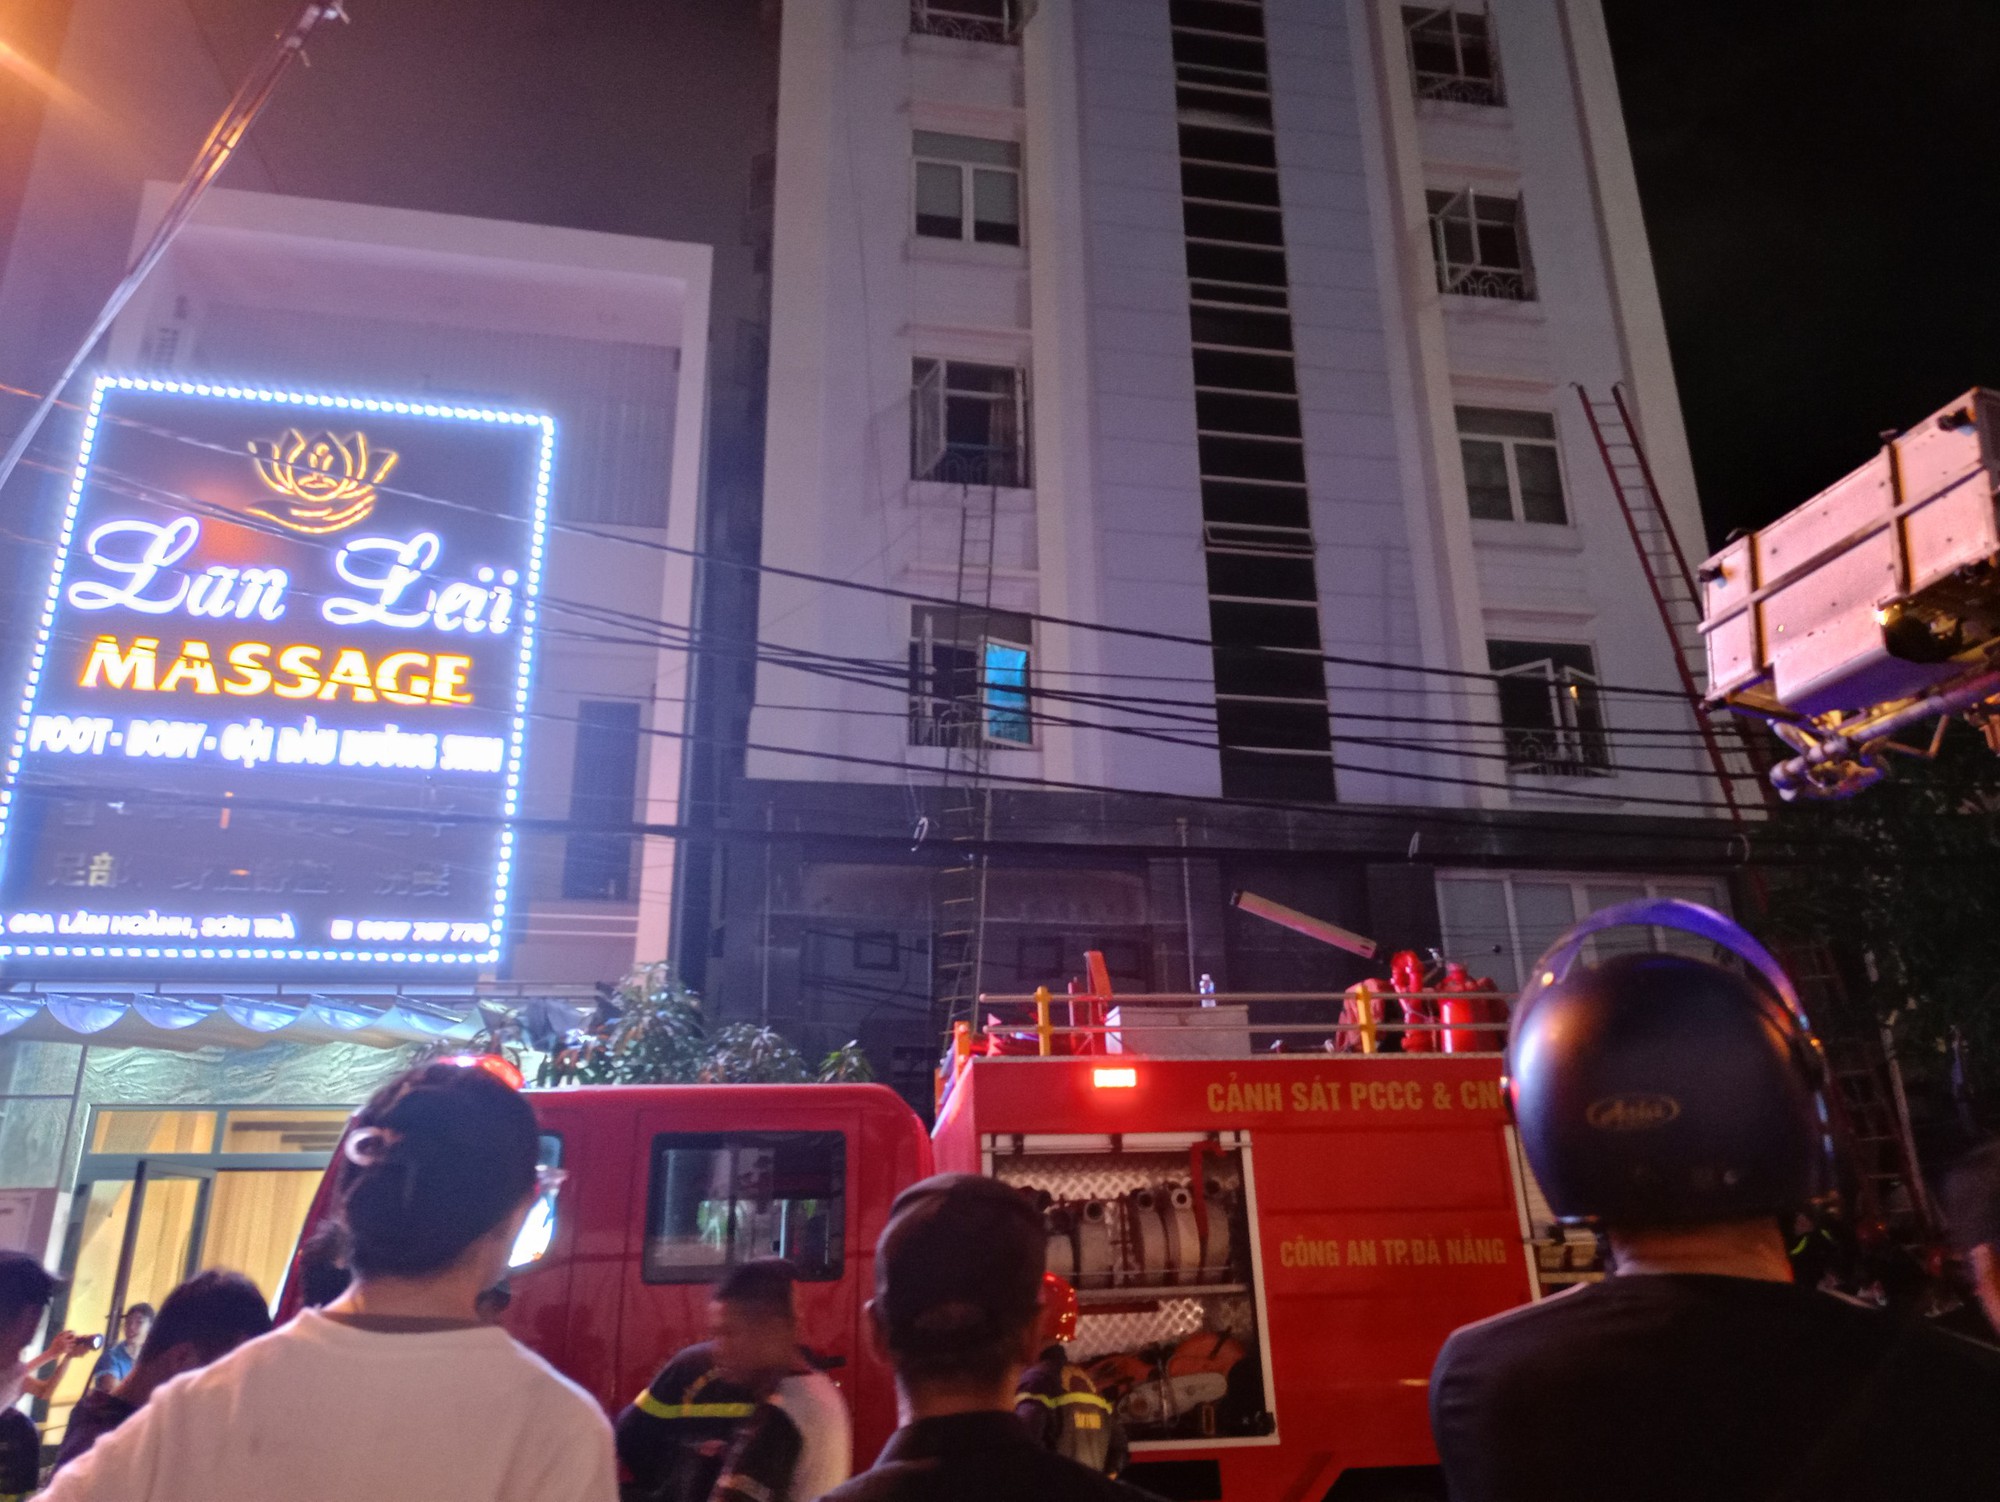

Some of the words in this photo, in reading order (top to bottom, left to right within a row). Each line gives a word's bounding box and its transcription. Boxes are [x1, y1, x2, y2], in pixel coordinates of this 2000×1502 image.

[80, 635, 474, 705] MASSAGE
[29, 715, 114, 754] FOOT
[1206, 1071, 1283, 1113] CẢNH
[1291, 1075, 1341, 1111] SÁT
[1351, 1080, 1424, 1111] PCCC
[1432, 1081, 1453, 1110] &
[1460, 1080, 1504, 1110] CN
[1279, 1234, 1340, 1267] CÔNG
[1346, 1239, 1377, 1266] AN
